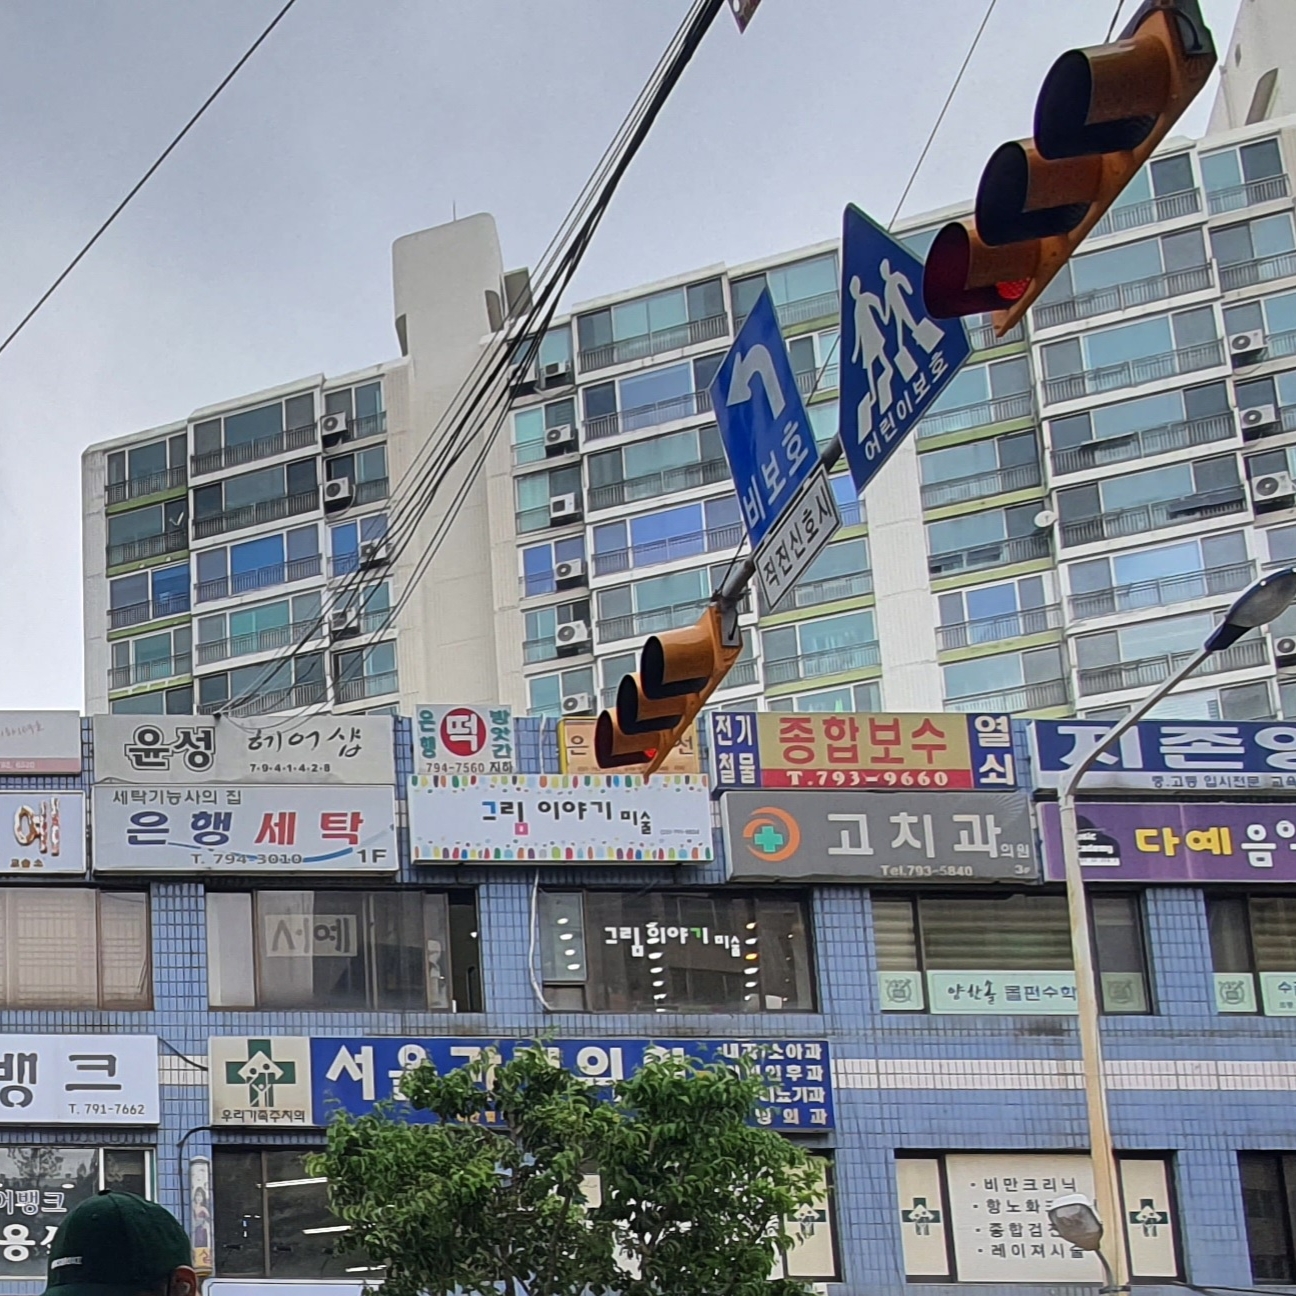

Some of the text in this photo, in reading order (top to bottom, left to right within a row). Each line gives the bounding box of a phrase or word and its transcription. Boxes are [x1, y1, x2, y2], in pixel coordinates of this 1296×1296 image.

[864, 352, 949, 461] 어린이보호
[742, 420, 809, 528] 비보호
[763, 486, 833, 586] 직진신호시
[445, 713, 478, 752] 떡
[490, 710, 513, 759] 방앗간
[715, 715, 753, 746] 전기
[778, 716, 947, 765] 종합보수
[124, 725, 216, 772] 윤성
[974, 715, 1015, 786] 열쇠
[426, 761, 513, 774] 794-7560 지하
[718, 753, 756, 785] 철물
[113, 790, 241, 805] 세탁기능사의 집
[482, 801, 652, 836] 그림 이야기 미술
[357, 849, 387, 863] 1F
[1135, 827, 1233, 857] 다예
[271, 918, 350, 953] 서예
[605, 927, 741, 958] 그림 이야기 미술
[85, 1104, 145, 1115] 791-7662
[221, 1110, 305, 1123] 우리가족주치의
[984, 1177, 1076, 1192] 비만크리닉
